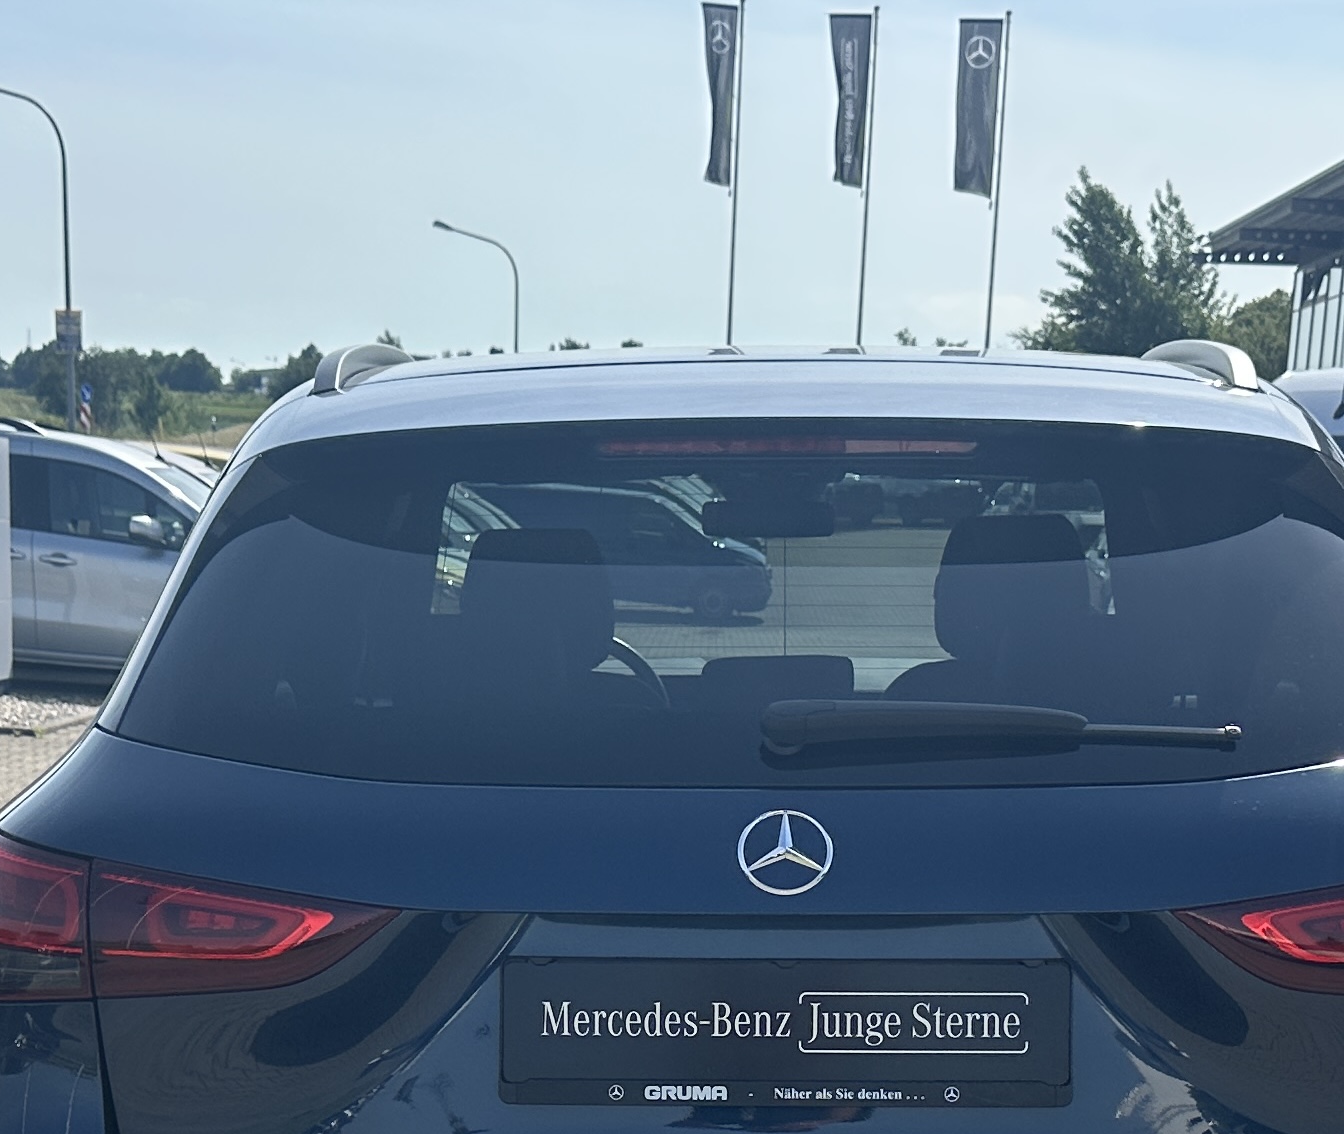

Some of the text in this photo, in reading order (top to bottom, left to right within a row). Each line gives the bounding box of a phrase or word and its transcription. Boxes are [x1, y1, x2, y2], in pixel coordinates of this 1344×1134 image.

[540, 1001, 1021, 1047] Mercedes-Benz Junge Sterne
[644, 1085, 728, 1101] GRUMA
[773, 1087, 813, 1100] Näher
[815, 1087, 833, 1100] als
[835, 1087, 855, 1100] Sie
[857, 1087, 903, 1100] denken
